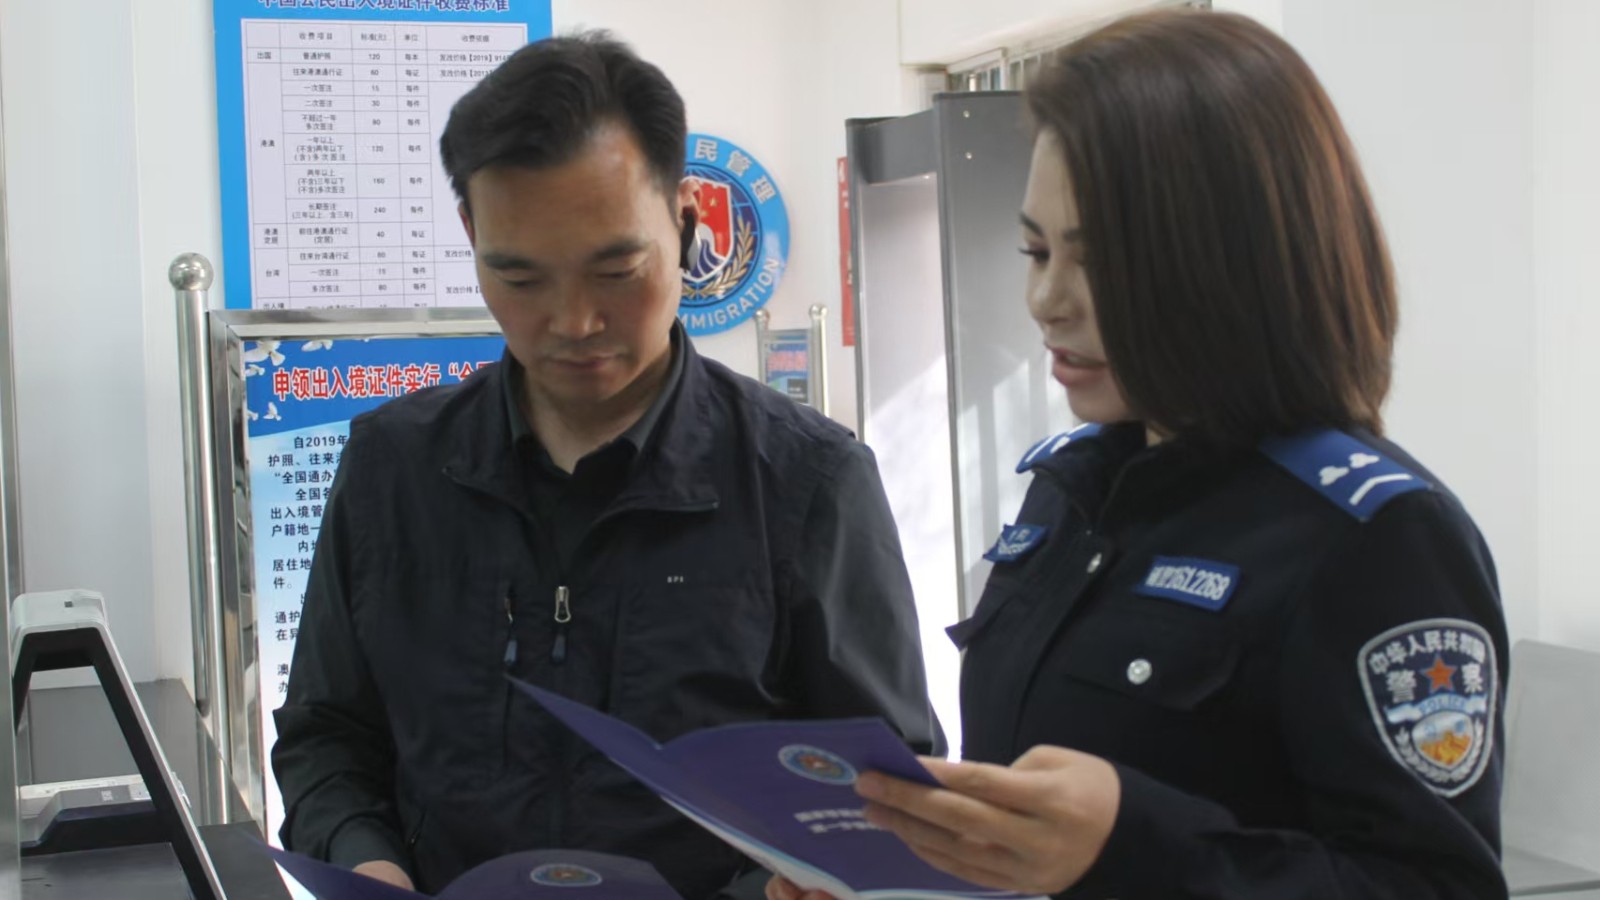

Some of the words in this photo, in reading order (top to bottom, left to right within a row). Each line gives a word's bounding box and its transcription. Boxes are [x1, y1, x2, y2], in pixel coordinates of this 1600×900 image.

[299, 32, 333, 40] 收费项目
[257, 52, 272, 60] 出国
[303, 52, 331, 60] 普通护照
[293, 68, 343, 77] 往来港澳通行证
[405, 69, 420, 77] 每证
[303, 83, 332, 92] 一次签注
[371, 84, 380, 92] 15
[406, 84, 420, 92] 每件
[305, 99, 333, 108] 二次签注
[406, 100, 420, 108] 每件
[302, 114, 337, 122] 不超过一年
[306, 123, 334, 131] 多次签注
[261, 139, 275, 148] 港澳
[307, 169, 335, 177] 两年以上
[309, 203, 337, 211] 长期签注
[374, 206, 386, 214] 240
[410, 206, 424, 214] 每件
[264, 228, 278, 236] 港澳
[299, 227, 348, 236] 前往港澳通行证
[412, 230, 425, 238] 每证
[264, 236, 278, 244] 定居
[300, 251, 350, 260] 往来台湾通行证
[265, 269, 280, 277] 台湾
[310, 268, 339, 276] 一次签注
[413, 267, 426, 275] 每件
[312, 285, 340, 293] 多次签注
[273, 362, 494, 401] 申领出入境证件实行“
[271, 505, 323, 519] 出入境管
[273, 558, 312, 572] 居住地
[275, 611, 300, 623] 通护
